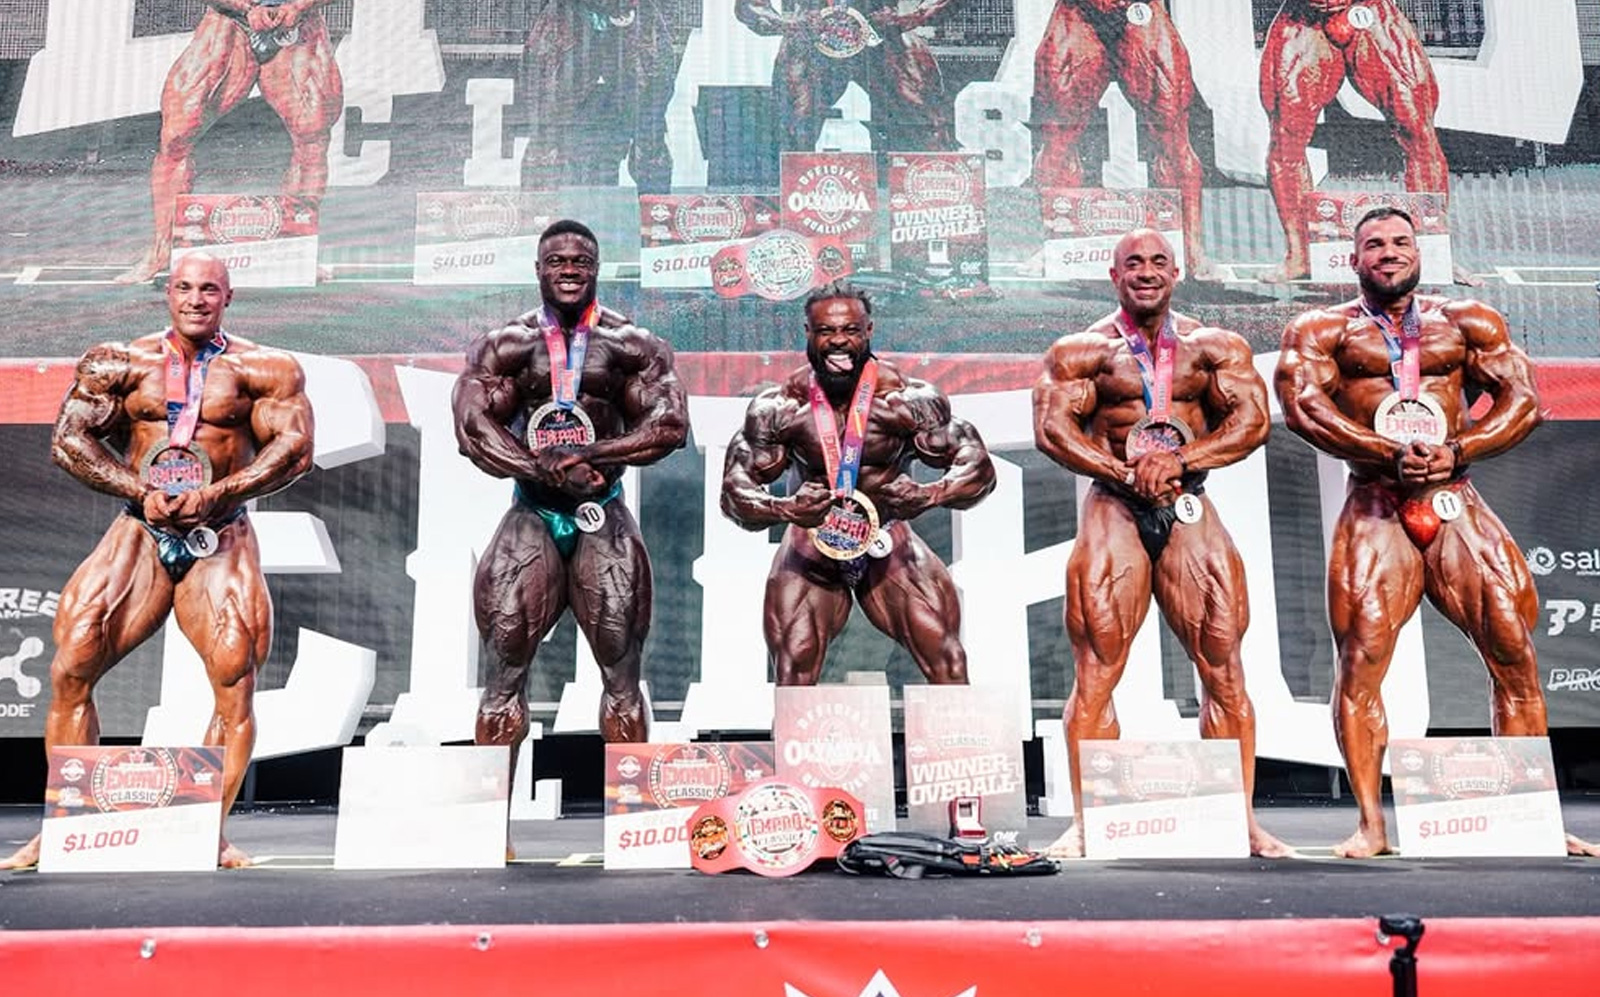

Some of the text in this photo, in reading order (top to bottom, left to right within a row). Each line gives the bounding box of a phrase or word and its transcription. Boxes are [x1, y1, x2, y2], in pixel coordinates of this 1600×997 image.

[799, 164, 860, 185] OFFICIAL
[803, 216, 861, 235] QUALIFIER
[893, 204, 976, 226] WINNER
[891, 219, 983, 243] OVERALL
[1440, 496, 1457, 514] 11
[582, 507, 600, 526] 10
[196, 533, 209, 551] 8
[911, 753, 1010, 784] WINNER
[110, 790, 158, 803] CLASSIC
[668, 786, 713, 799] CLASSIC
[909, 774, 1019, 806] OVERALL
[1453, 780, 1497, 792] CLASSIC
[1105, 816, 1177, 841] $2.000
[1418, 814, 1489, 839] $1.000
[63, 828, 140, 853] $1.000
